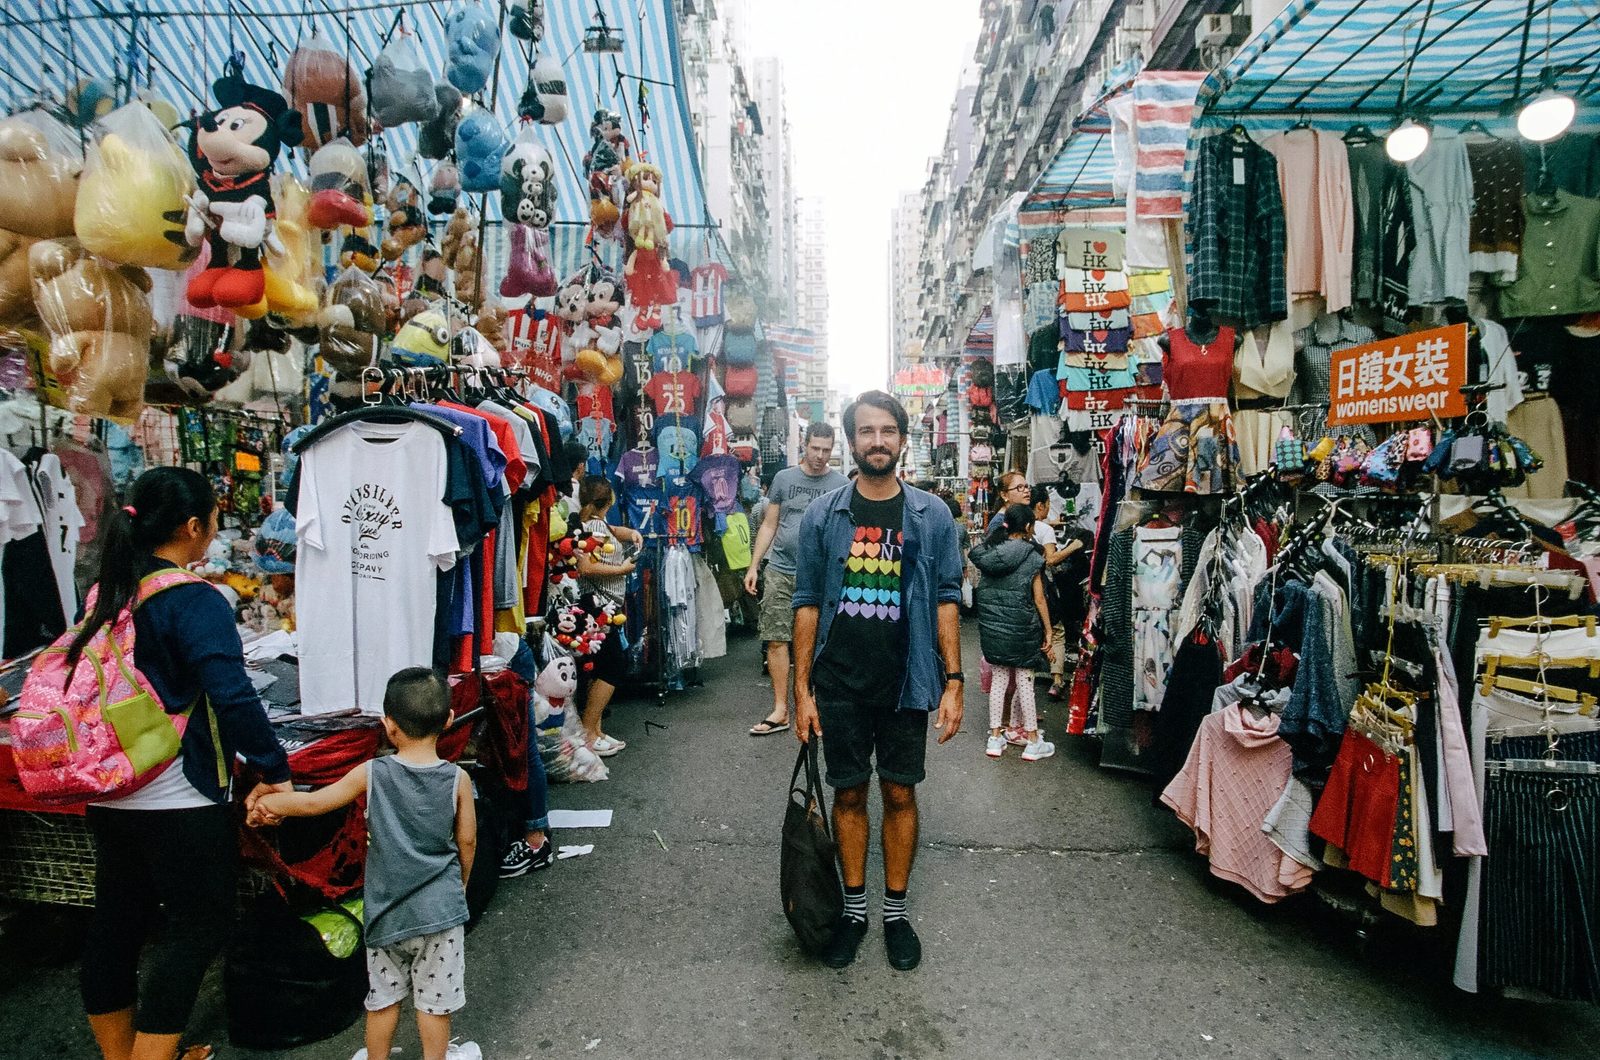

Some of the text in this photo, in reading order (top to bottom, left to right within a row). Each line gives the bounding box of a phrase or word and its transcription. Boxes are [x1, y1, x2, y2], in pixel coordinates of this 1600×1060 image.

[1083, 240, 1091, 254] I
[1083, 255, 1107, 267] HK
[1084, 293, 1109, 307] HK
[1084, 343, 1107, 353] HK
[1337, 337, 1449, 399] 日韓女裝
[662, 383, 684, 391] MÜLER
[1089, 376, 1112, 389] HK
[662, 392, 685, 413] 25
[1336, 391, 1449, 419] womenswear
[1091, 414, 1113, 427] HK
[639, 507, 652, 530] 7
[674, 507, 691, 531] 10
[886, 528, 893, 544] I
